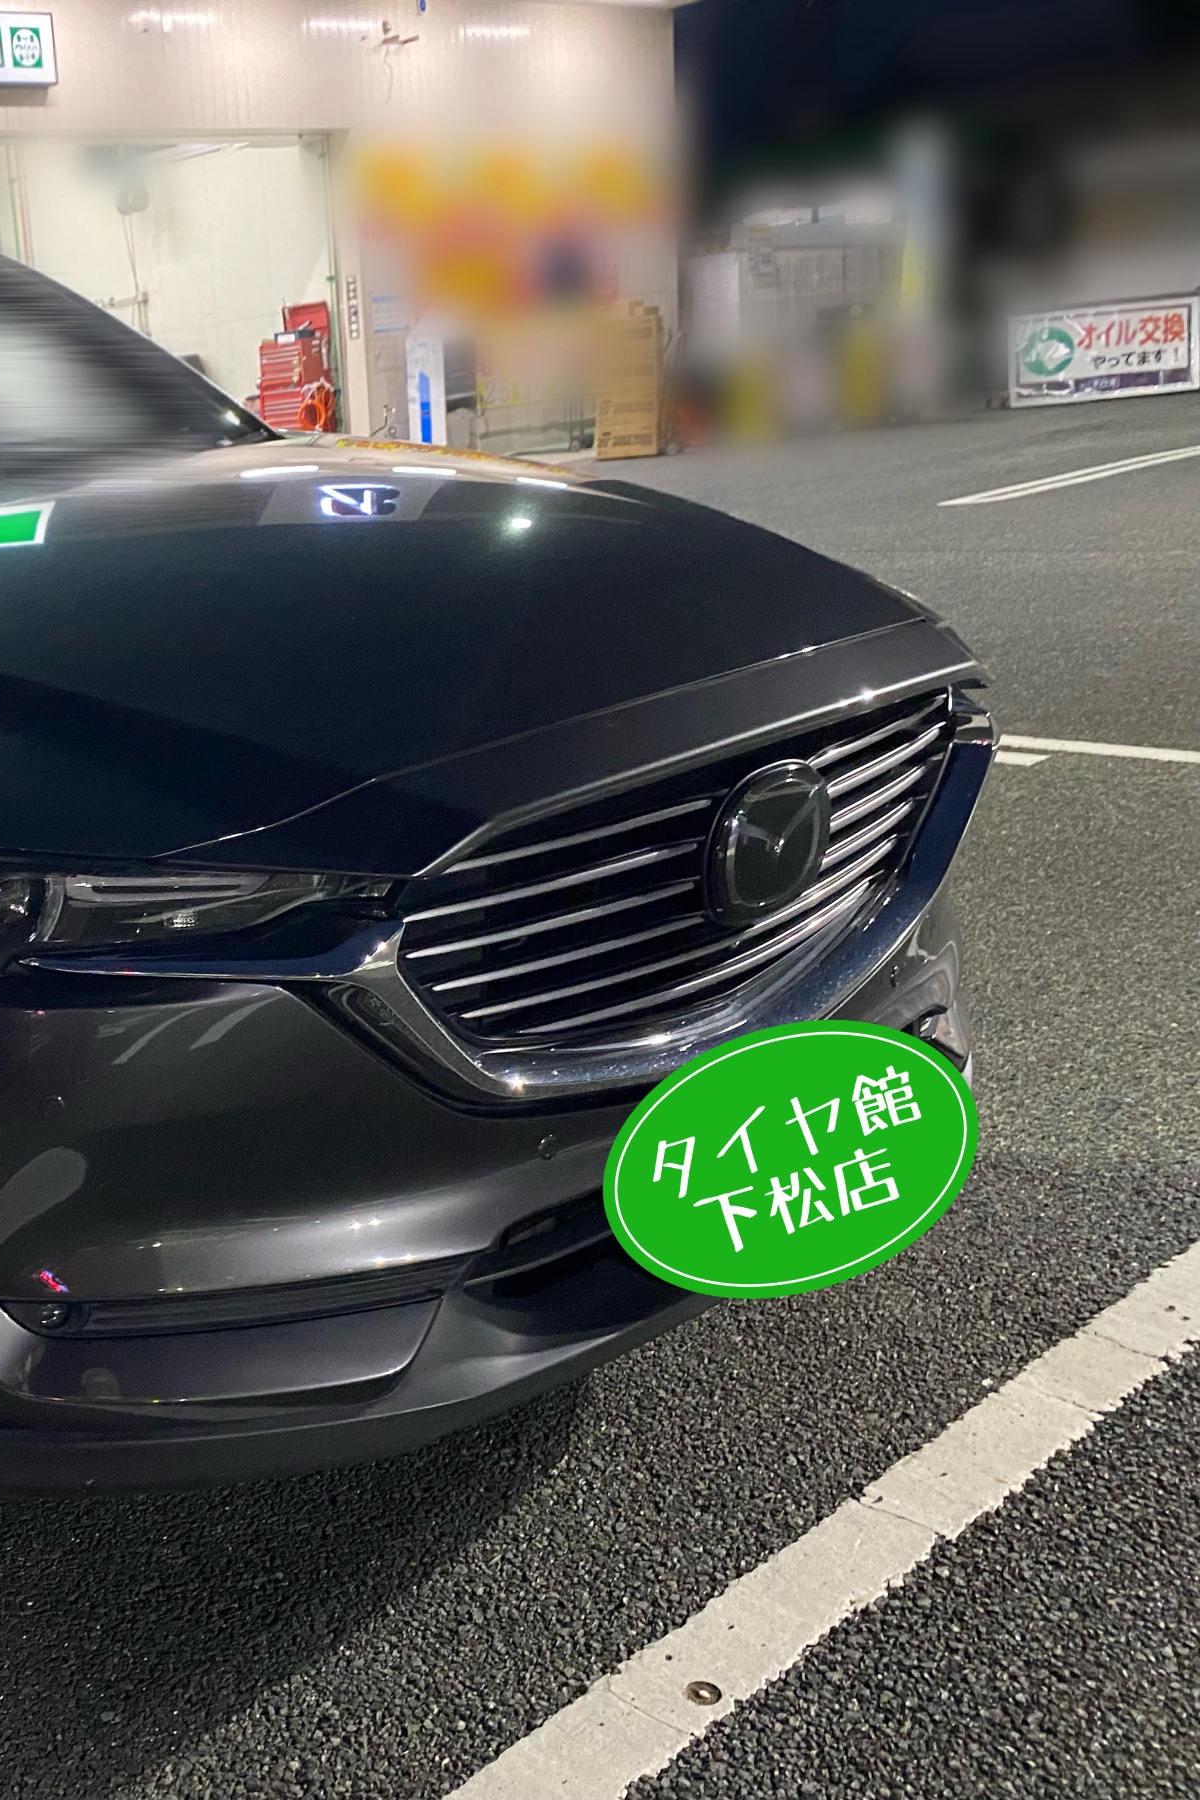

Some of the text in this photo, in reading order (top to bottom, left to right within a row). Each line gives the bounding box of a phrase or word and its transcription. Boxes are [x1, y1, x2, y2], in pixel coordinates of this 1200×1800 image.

[1077, 312, 1186, 350] オイル交換
